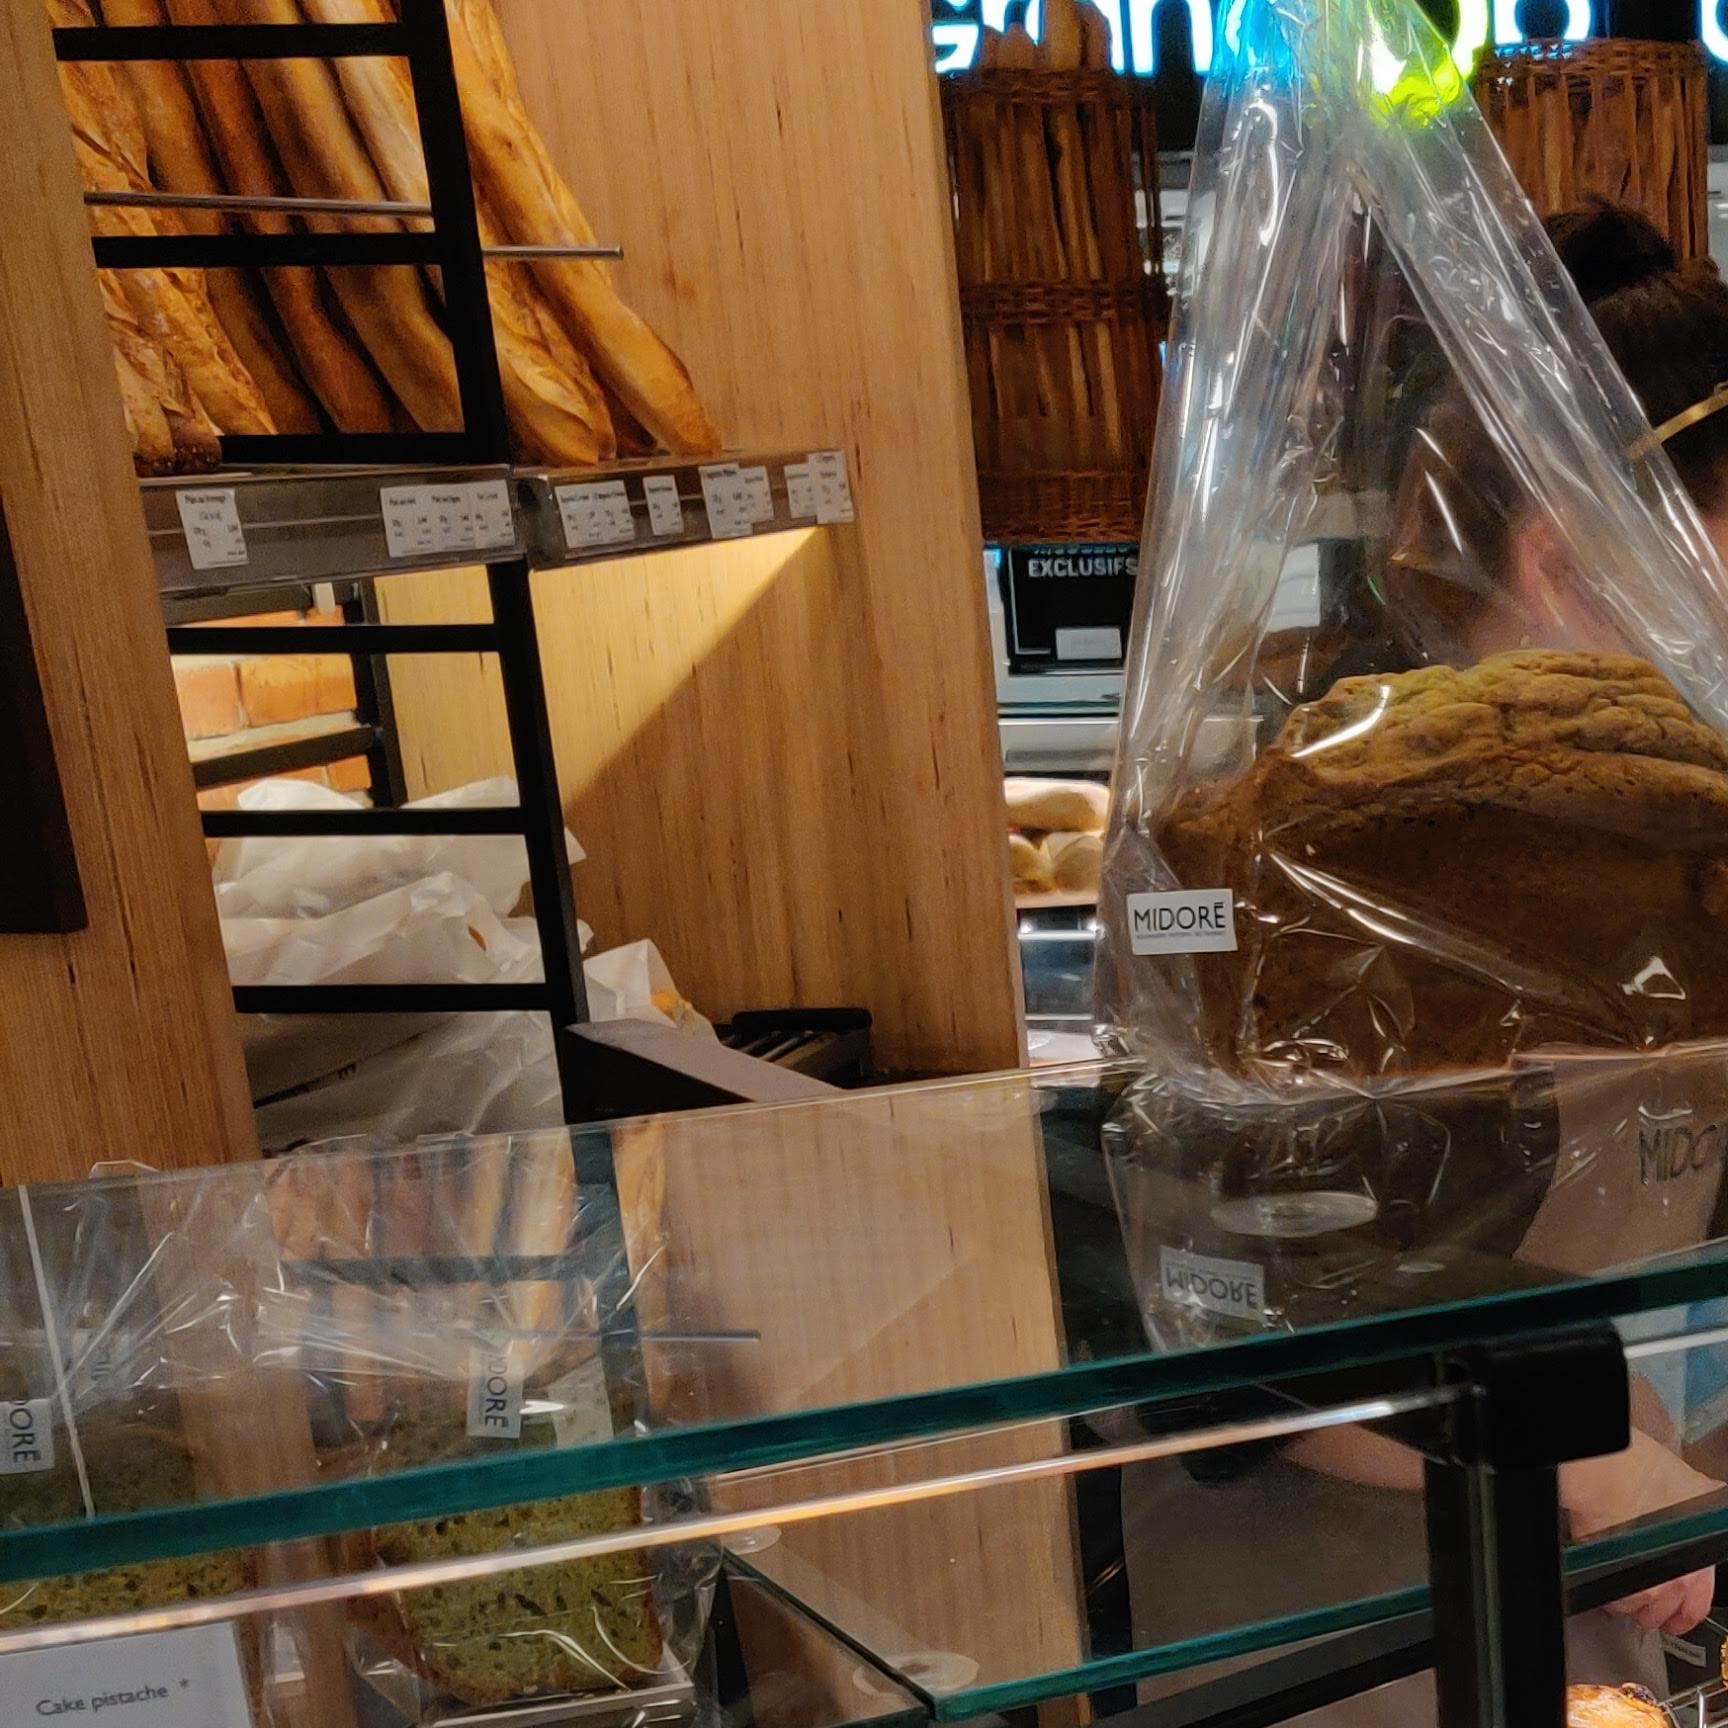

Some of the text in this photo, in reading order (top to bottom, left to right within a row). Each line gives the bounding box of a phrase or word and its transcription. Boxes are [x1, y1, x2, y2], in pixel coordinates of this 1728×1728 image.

[1028, 556, 1137, 578] EXCLUSIFS
[1134, 901, 1226, 933] MIDORÉ
[36, 1685, 169, 1716] Cake pistache
